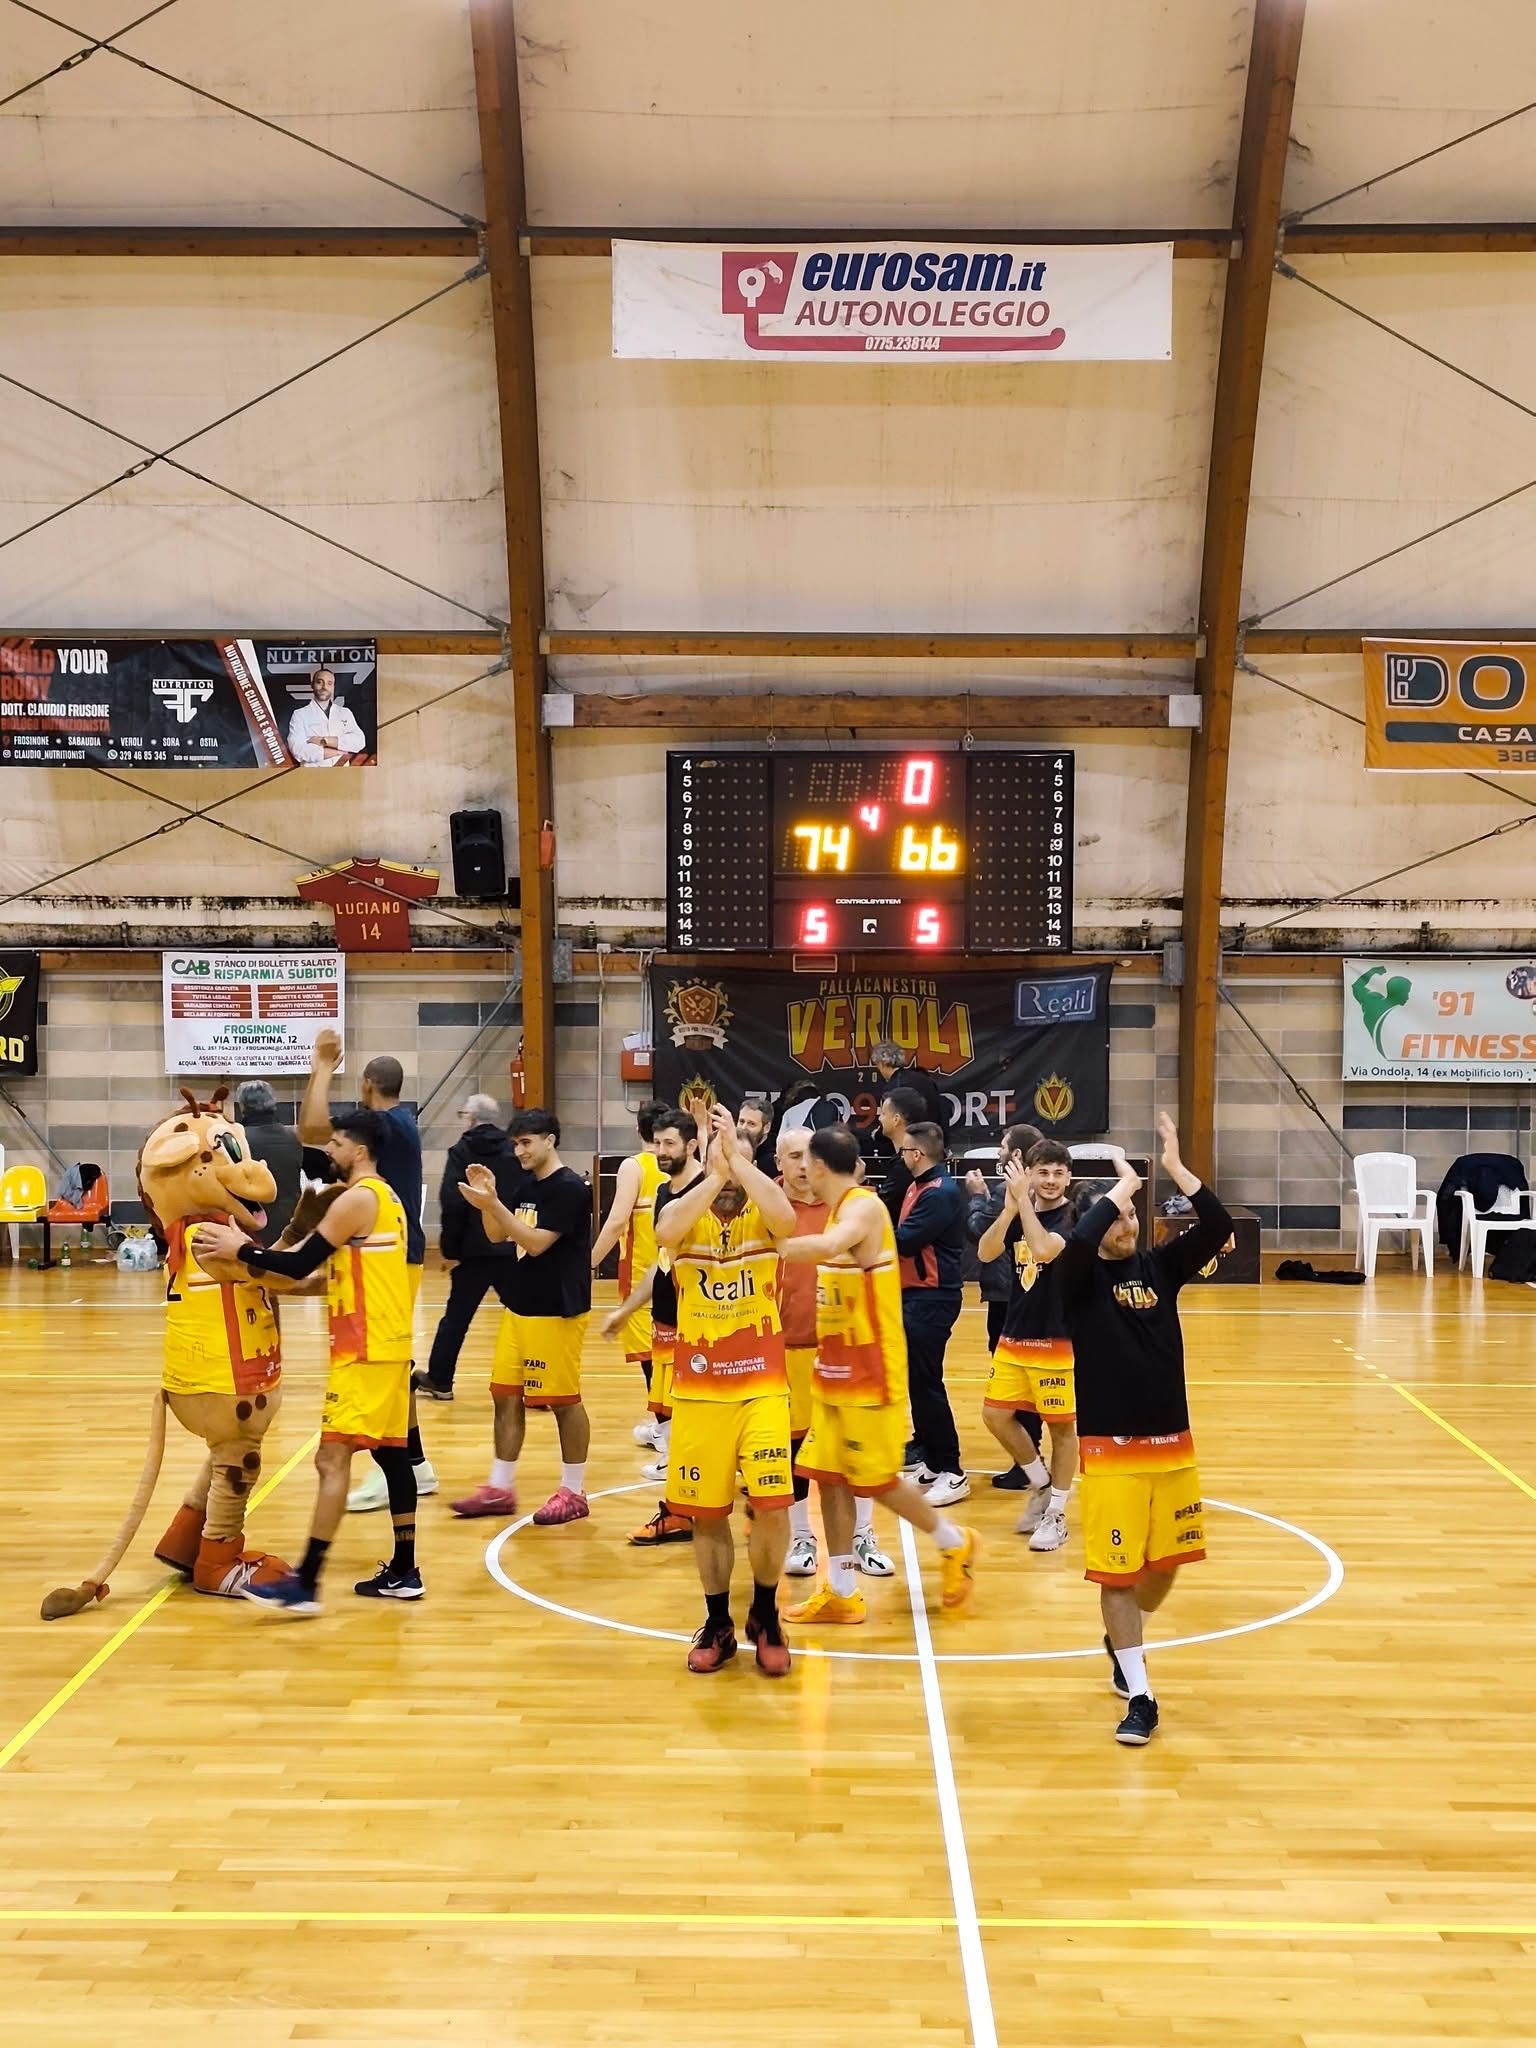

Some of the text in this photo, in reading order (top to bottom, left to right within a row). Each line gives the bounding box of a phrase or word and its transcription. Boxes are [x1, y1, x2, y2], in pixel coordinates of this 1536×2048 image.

[802, 252, 1046, 293] eurosam.it
[795, 300, 1050, 327] AUTONOLEGGIO
[865, 336, 941, 351] 0775.238144
[58, 649, 109, 674] YOUR
[267, 649, 375, 663] NUTRITION
[152, 681, 214, 689] NUTRITION
[1, 703, 110, 718] DOTT. CLAUDIO FRUSONE
[1458, 727, 1533, 742] CASA
[67, 736, 102, 746] SABAUDIA
[682, 759, 692, 771] 4
[1053, 759, 1063, 771] 4
[682, 775, 692, 787] 5
[903, 760, 933, 804] 0
[1053, 775, 1063, 787] 5
[682, 791, 692, 803] 6
[1053, 791, 1063, 803] 6
[682, 806, 692, 818] 7
[860, 805, 879, 830] 4
[1053, 806, 1063, 818] 7
[682, 823, 692, 835] 8
[1053, 823, 1063, 835] 8
[682, 838, 692, 850] 9
[794, 827, 849, 870] 74
[900, 827, 957, 871] 66
[676, 855, 692, 867] 10
[1047, 855, 1063, 867] 10
[676, 870, 692, 882] 11
[1047, 870, 1063, 882] 11
[676, 886, 692, 898] 12
[336, 901, 400, 915] LUCIANO
[676, 902, 692, 914] 13
[1047, 902, 1063, 914] 13
[676, 918, 692, 930] 14
[803, 907, 828, 944] 5
[916, 907, 941, 944] 5
[1047, 918, 1063, 930] 14
[361, 922, 381, 940] 14
[676, 934, 692, 946] 15
[171, 959, 211, 976] CAB
[214, 960, 247, 968] STANCO
[301, 959, 337, 967] SALATE?
[214, 967, 337, 980] RISPARMIA SUBITO!
[819, 979, 937, 996] PALLACANESTRO
[1029, 986, 1087, 1013] Reali
[1432, 991, 1475, 1016] '91
[224, 1024, 287, 1034] FROSINONE
[787, 995, 975, 1074] VEROLI
[213, 1036, 298, 1045] VIA TIBURTINA, 12
[1401, 1034, 1536, 1060] FITNESS
[1351, 1067, 1524, 1079] Via Ondola, 14 (ex Mobilificio Iori)
[696, 1268, 756, 1301] Reali
[678, 1465, 701, 1481] 16
[1111, 1528, 1122, 1546] 8
